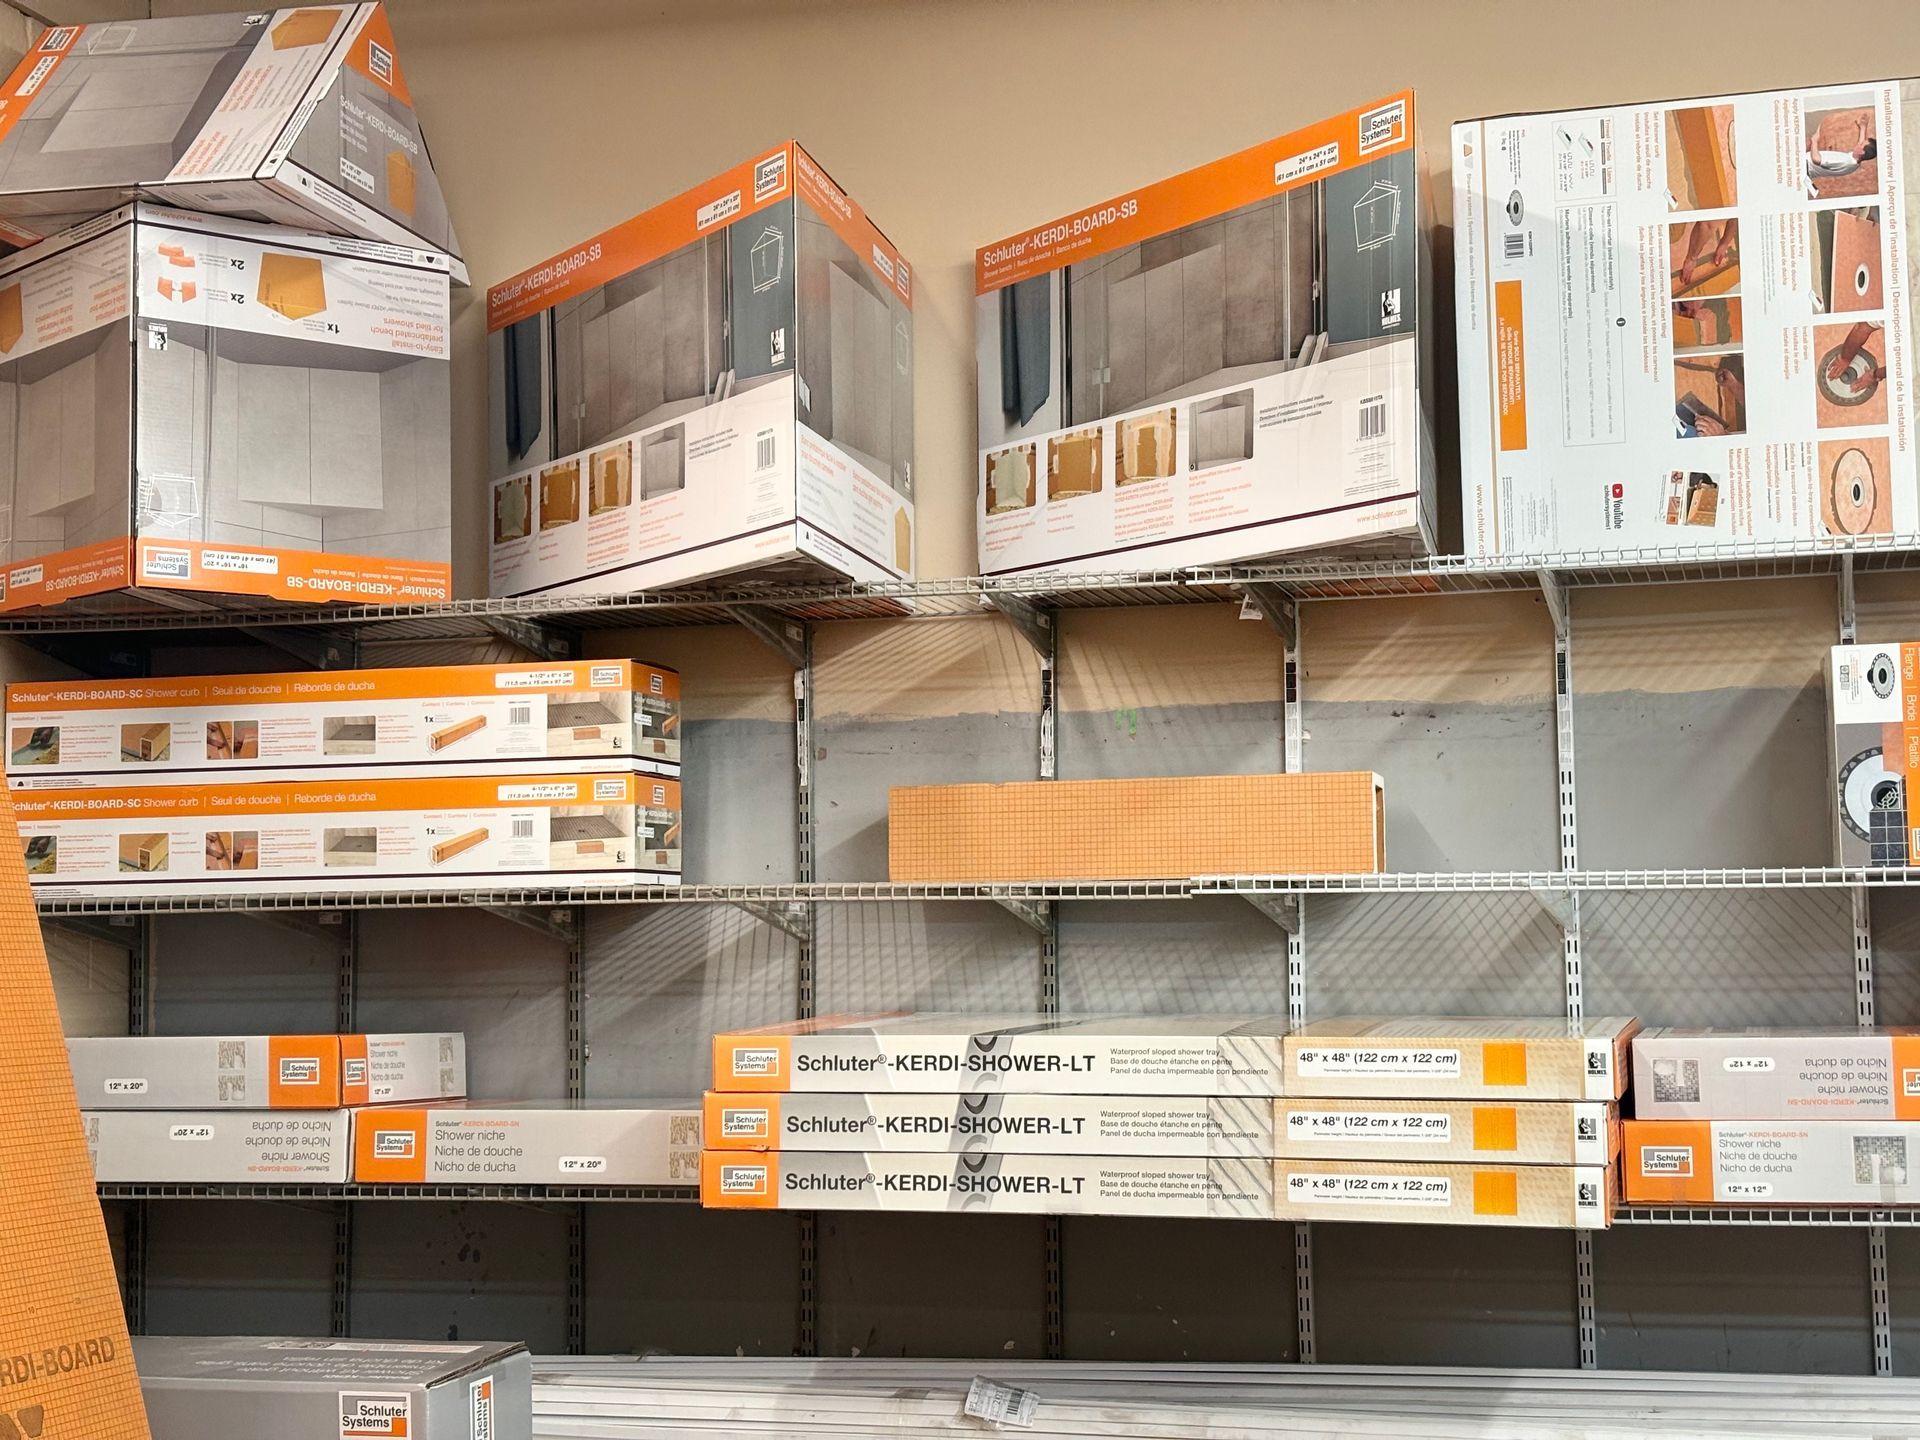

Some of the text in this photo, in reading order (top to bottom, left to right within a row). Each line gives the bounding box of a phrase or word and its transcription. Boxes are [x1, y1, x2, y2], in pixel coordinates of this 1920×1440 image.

[1372, 114, 1402, 130] Schluter
[1361, 126, 1391, 144] Systems
[764, 163, 785, 179] Schluter
[756, 176, 777, 192] Systems
[231, 259, 245, 270] 2x
[1884, 89, 1907, 452] Installation overview Aperçu de l'installation Descripción general de la instalación
[231, 292, 245, 304] 2x
[328, 323, 340, 334] 1x
[384, 318, 414, 328] showers
[370, 326, 443, 342] prefabricated bench
[392, 340, 443, 354] Easy-to-install
[1614, 499, 1624, 529] YouTube
[158, 555, 188, 564] Systems
[146, 562, 177, 570] Schluter
[146, 688, 177, 698] Shower
[180, 688, 200, 696] curb
[212, 686, 233, 696] Seuil
[235, 686, 246, 694] de
[249, 684, 281, 694] douche
[294, 682, 331, 692] Reborde
[334, 682, 345, 691] de
[348, 682, 376, 691] ducha
[1904, 647, 1919, 768] Flange Bride Platillo
[144, 798, 177, 808] Shower
[178, 798, 198, 806] curb
[211, 796, 233, 806] Seuil
[235, 796, 246, 805] de
[248, 796, 281, 804] douche
[294, 794, 332, 804] Reborde
[335, 794, 346, 802] de
[348, 792, 376, 802] ducha
[1110, 1048, 1150, 1056] Waterproof
[797, 1054, 1096, 1072] Schluter®-KERDI-SHOWER-LT
[1300, 1053, 1318, 1062] 48"
[1332, 1053, 1350, 1062] 48"
[1354, 1053, 1378, 1064] (122
[1381, 1055, 1398, 1063] cm
[1412, 1054, 1432, 1063] 122
[1435, 1054, 1457, 1064] cm)
[1805, 1058, 1887, 1067] Nicho de ducha
[735, 1062, 766, 1070] Systems
[1168, 1068, 1214, 1076] impermeable
[1800, 1072, 1887, 1081] Niche de douche
[108, 1082, 122, 1090] 12"
[130, 1082, 144, 1090] 20"
[1818, 1086, 1888, 1095] Shower niche
[252, 1121, 332, 1132] Nicho de ducha
[724, 1123, 755, 1131] Systems
[787, 1115, 1086, 1134] Schluter®-KERDI-SHOWER-LT
[435, 1130, 505, 1141] Shower niche
[245, 1137, 330, 1147] Niche de douche
[1719, 1139, 1781, 1148] Shower niche
[435, 1145, 523, 1156] Niche de douche
[1720, 1152, 1797, 1160] Niche de douche
[261, 1152, 330, 1162] Shower niche
[434, 1161, 516, 1172] Nicho de ducha
[1644, 1161, 1677, 1169] Systems
[1720, 1164, 1792, 1172] Nicho de ducha
[723, 1180, 754, 1188] Systems
[785, 1173, 1085, 1194] Schluter®-KERDI-SHOWER-LT
[360, 1405, 407, 1416] Schluter
[342, 1416, 389, 1429] Systems
